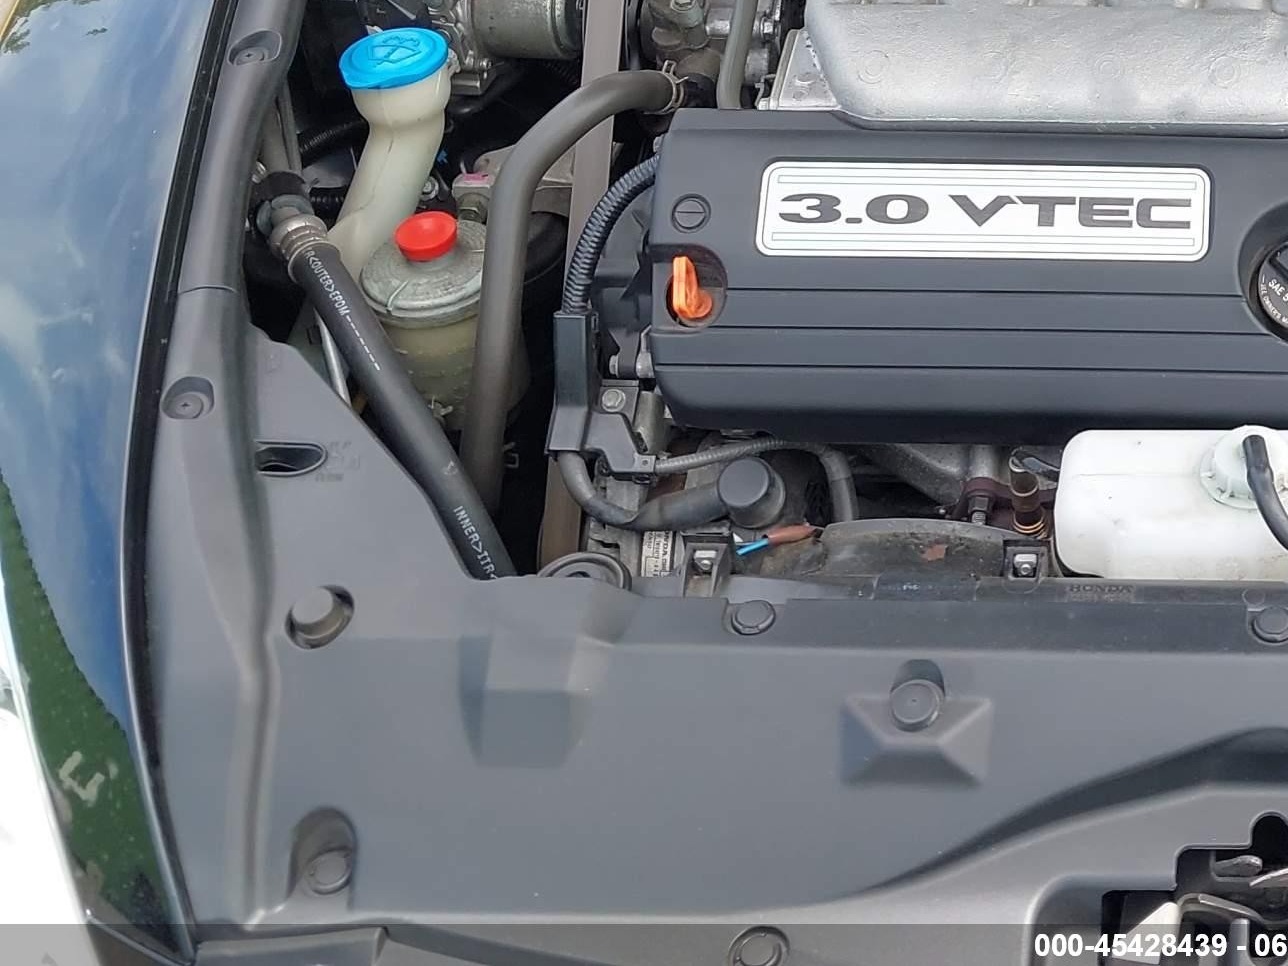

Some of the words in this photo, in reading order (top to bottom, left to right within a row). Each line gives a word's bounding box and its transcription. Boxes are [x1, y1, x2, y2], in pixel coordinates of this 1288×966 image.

[778, 193, 930, 225] 3.0
[948, 194, 1192, 229] VTEC
[1268, 278, 1285, 295] SAE
